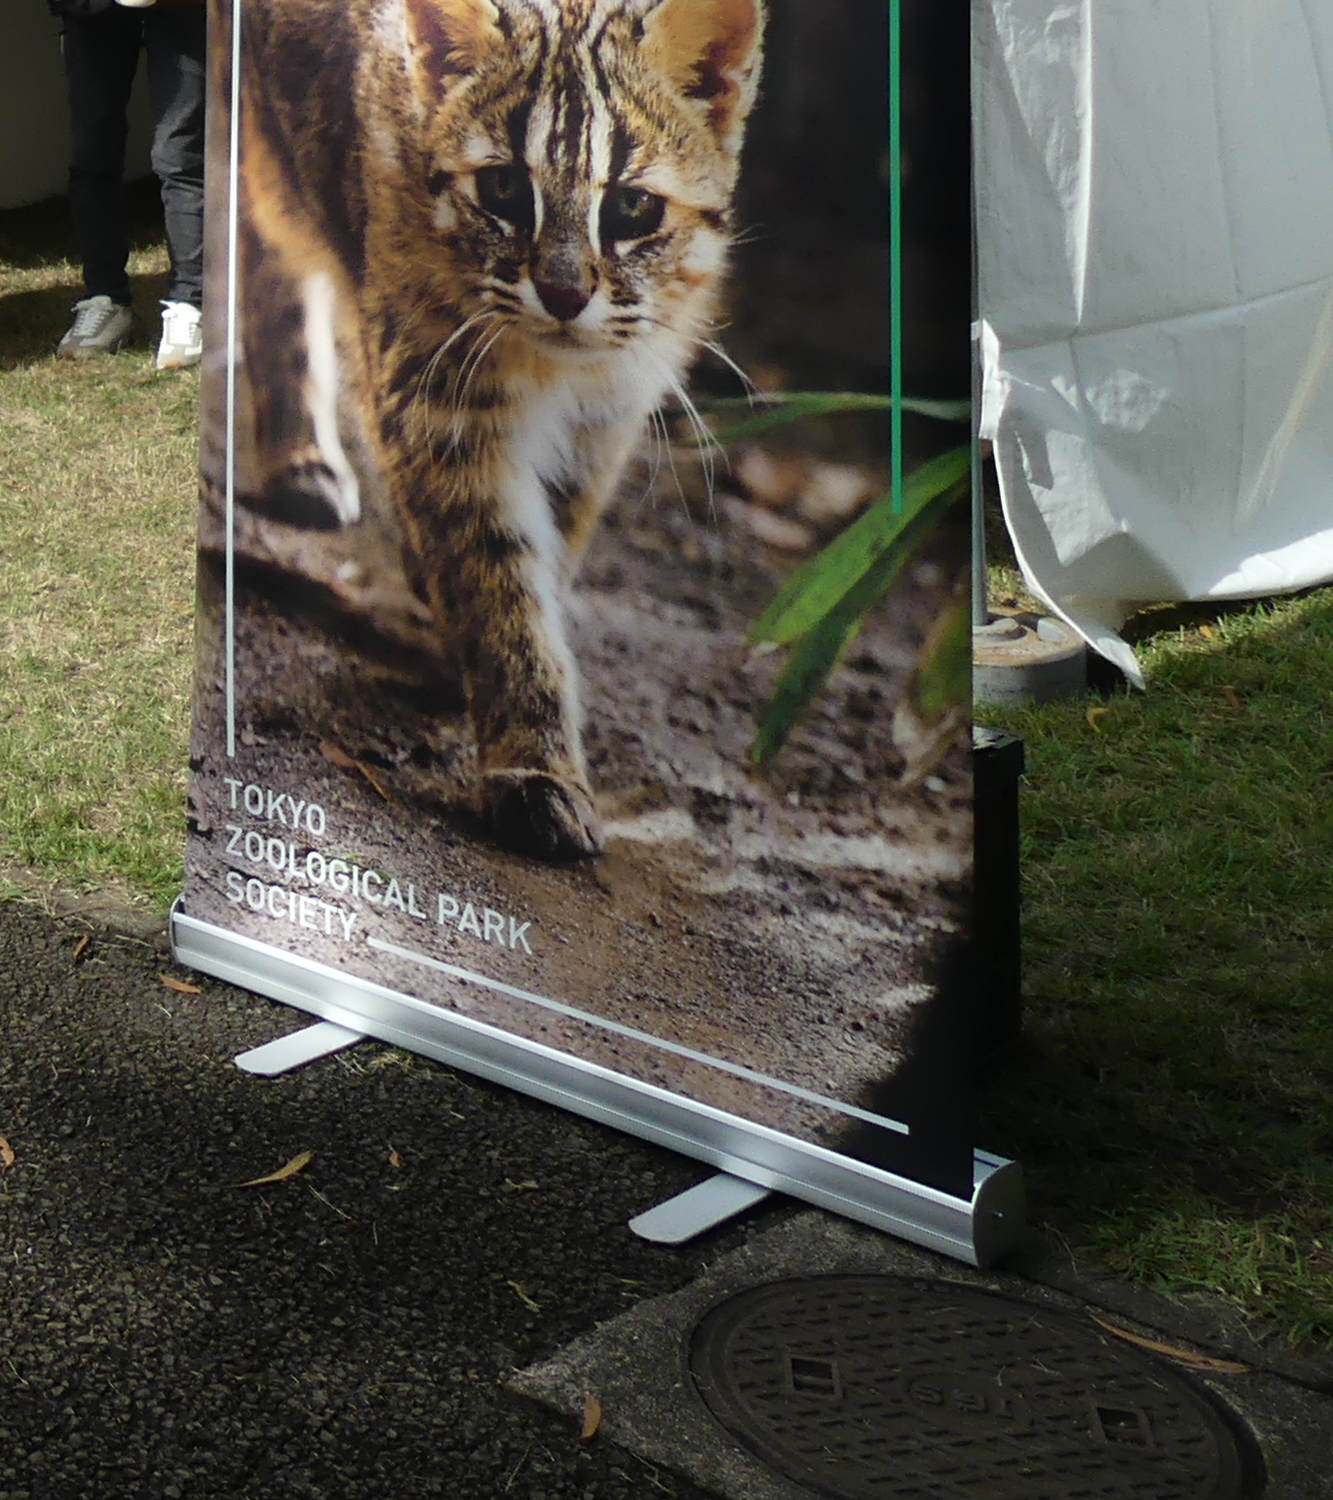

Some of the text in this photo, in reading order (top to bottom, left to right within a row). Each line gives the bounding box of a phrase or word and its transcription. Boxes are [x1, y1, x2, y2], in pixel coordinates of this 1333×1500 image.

[224, 777, 326, 836] TOKYO
[225, 824, 533, 955] ZOOLOGICAL PARK
[225, 871, 357, 942] SOCIETY
